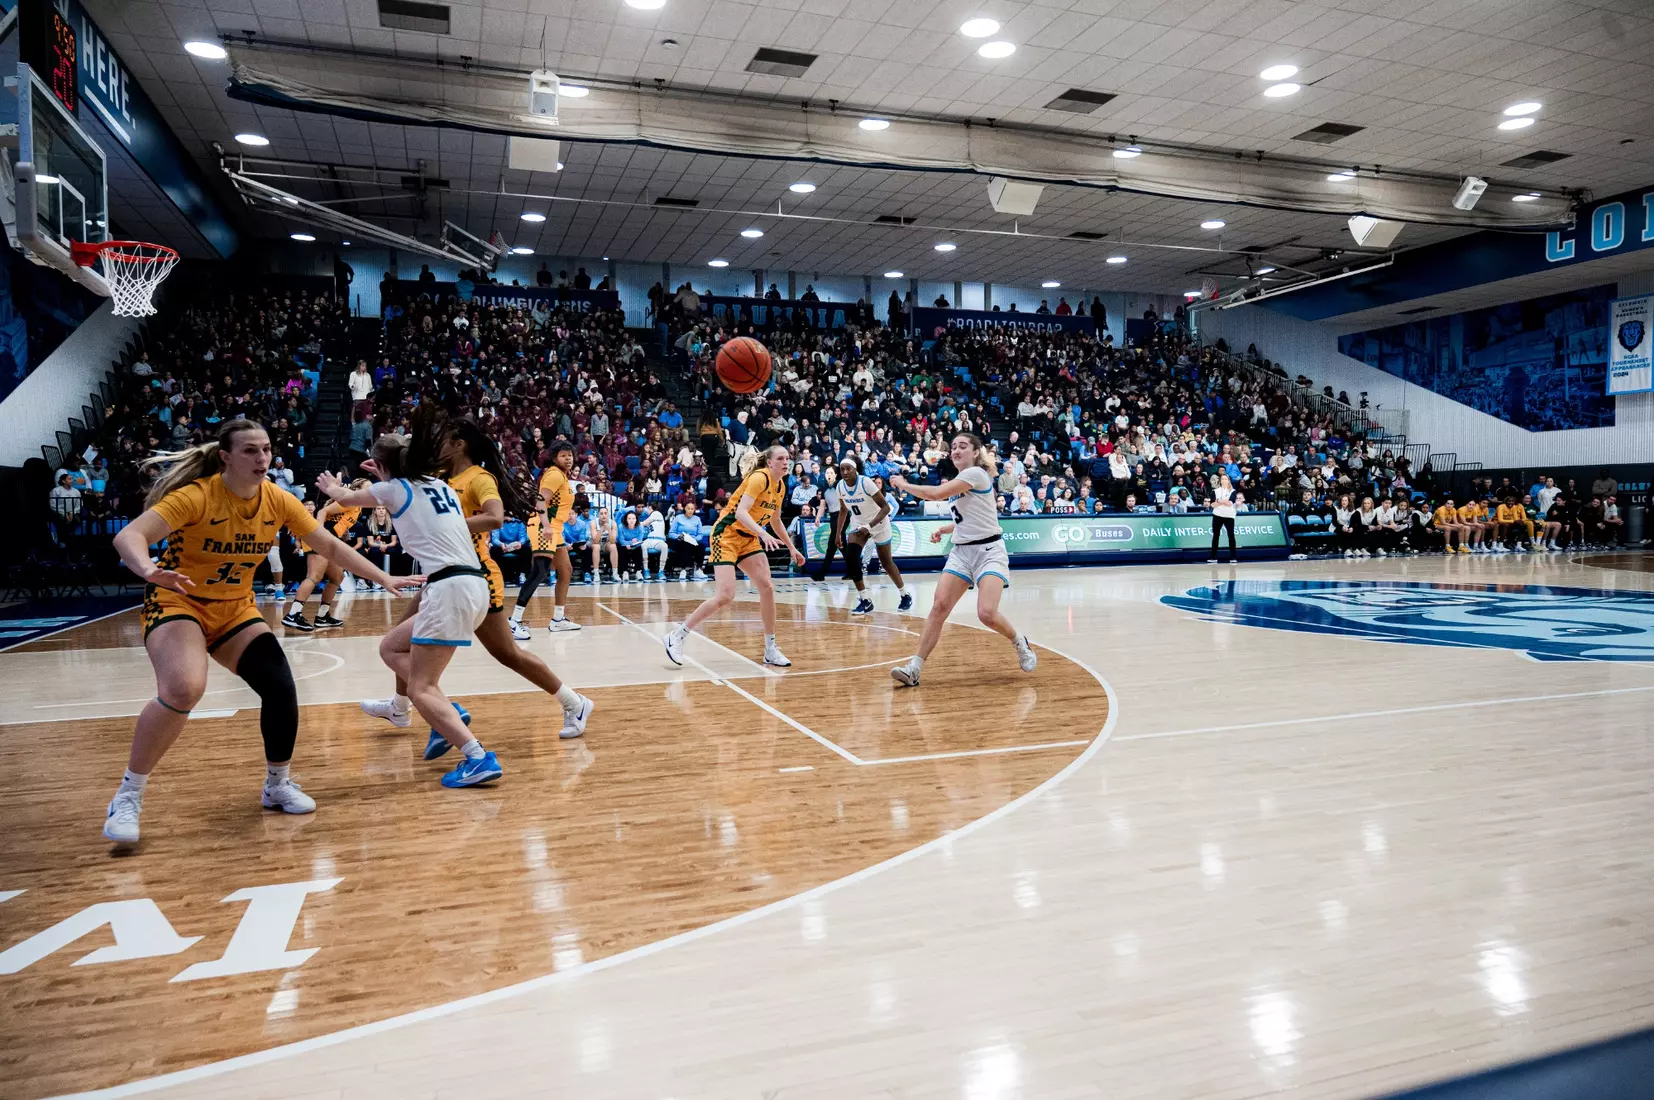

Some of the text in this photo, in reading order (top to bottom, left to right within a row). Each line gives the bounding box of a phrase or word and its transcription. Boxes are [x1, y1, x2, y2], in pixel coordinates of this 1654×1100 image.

[422, 486, 461, 515] 24
[1050, 505, 1068, 514] POSS
[1001, 531, 1040, 541] es.com
[1054, 526, 1085, 542] GO
[1095, 529, 1123, 538] Buses
[1142, 528, 1170, 537] DAILY
[1234, 525, 1274, 535] SERVICE
[202, 538, 271, 555] FRANCISC
